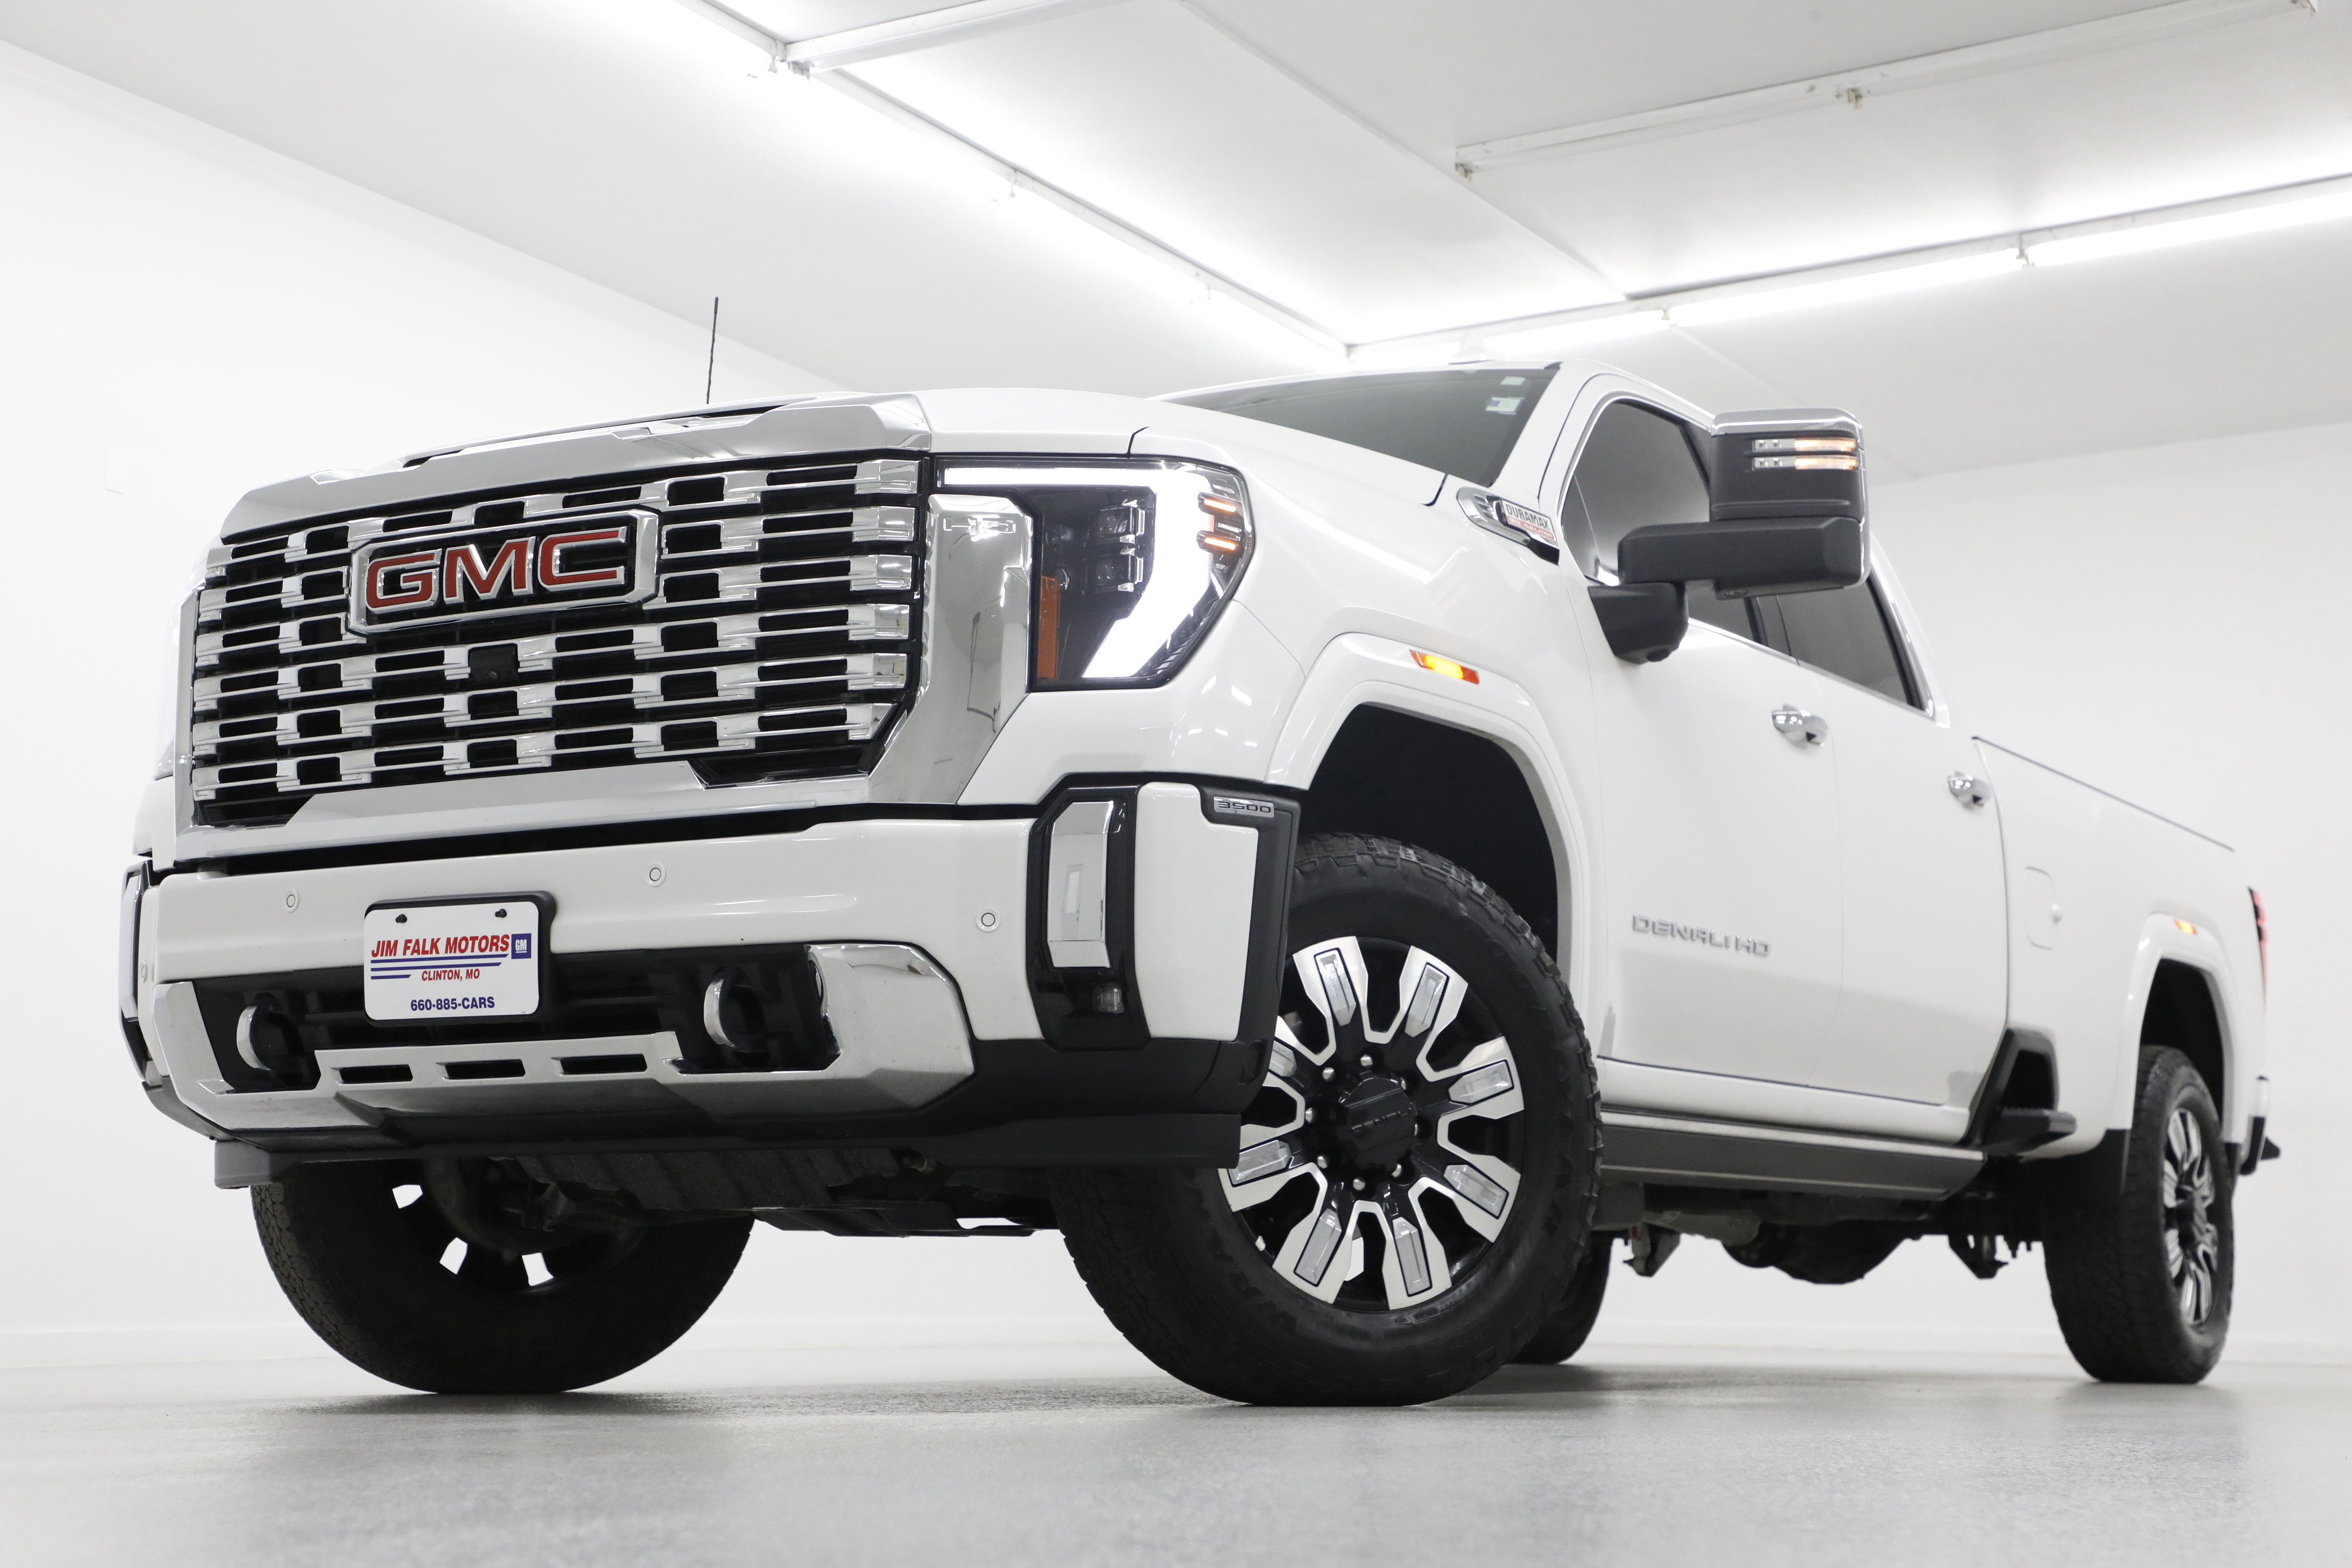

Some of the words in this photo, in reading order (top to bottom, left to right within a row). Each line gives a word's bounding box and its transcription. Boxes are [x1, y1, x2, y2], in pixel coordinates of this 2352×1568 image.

[1506, 504, 1550, 530] DURAMAX
[366, 526, 628, 614] GMC
[1218, 802, 1271, 813] 3500
[1633, 913, 1731, 949] DENALI
[1735, 934, 1771, 957] HD
[371, 940, 399, 958] JIM
[403, 938, 441, 956] FALK
[445, 934, 510, 954] MOTORS
[515, 939, 527, 951] GM
[421, 969, 463, 982] CLINTON,
[466, 969, 480, 980] MO
[410, 996, 495, 1011] 660-885-CARS
